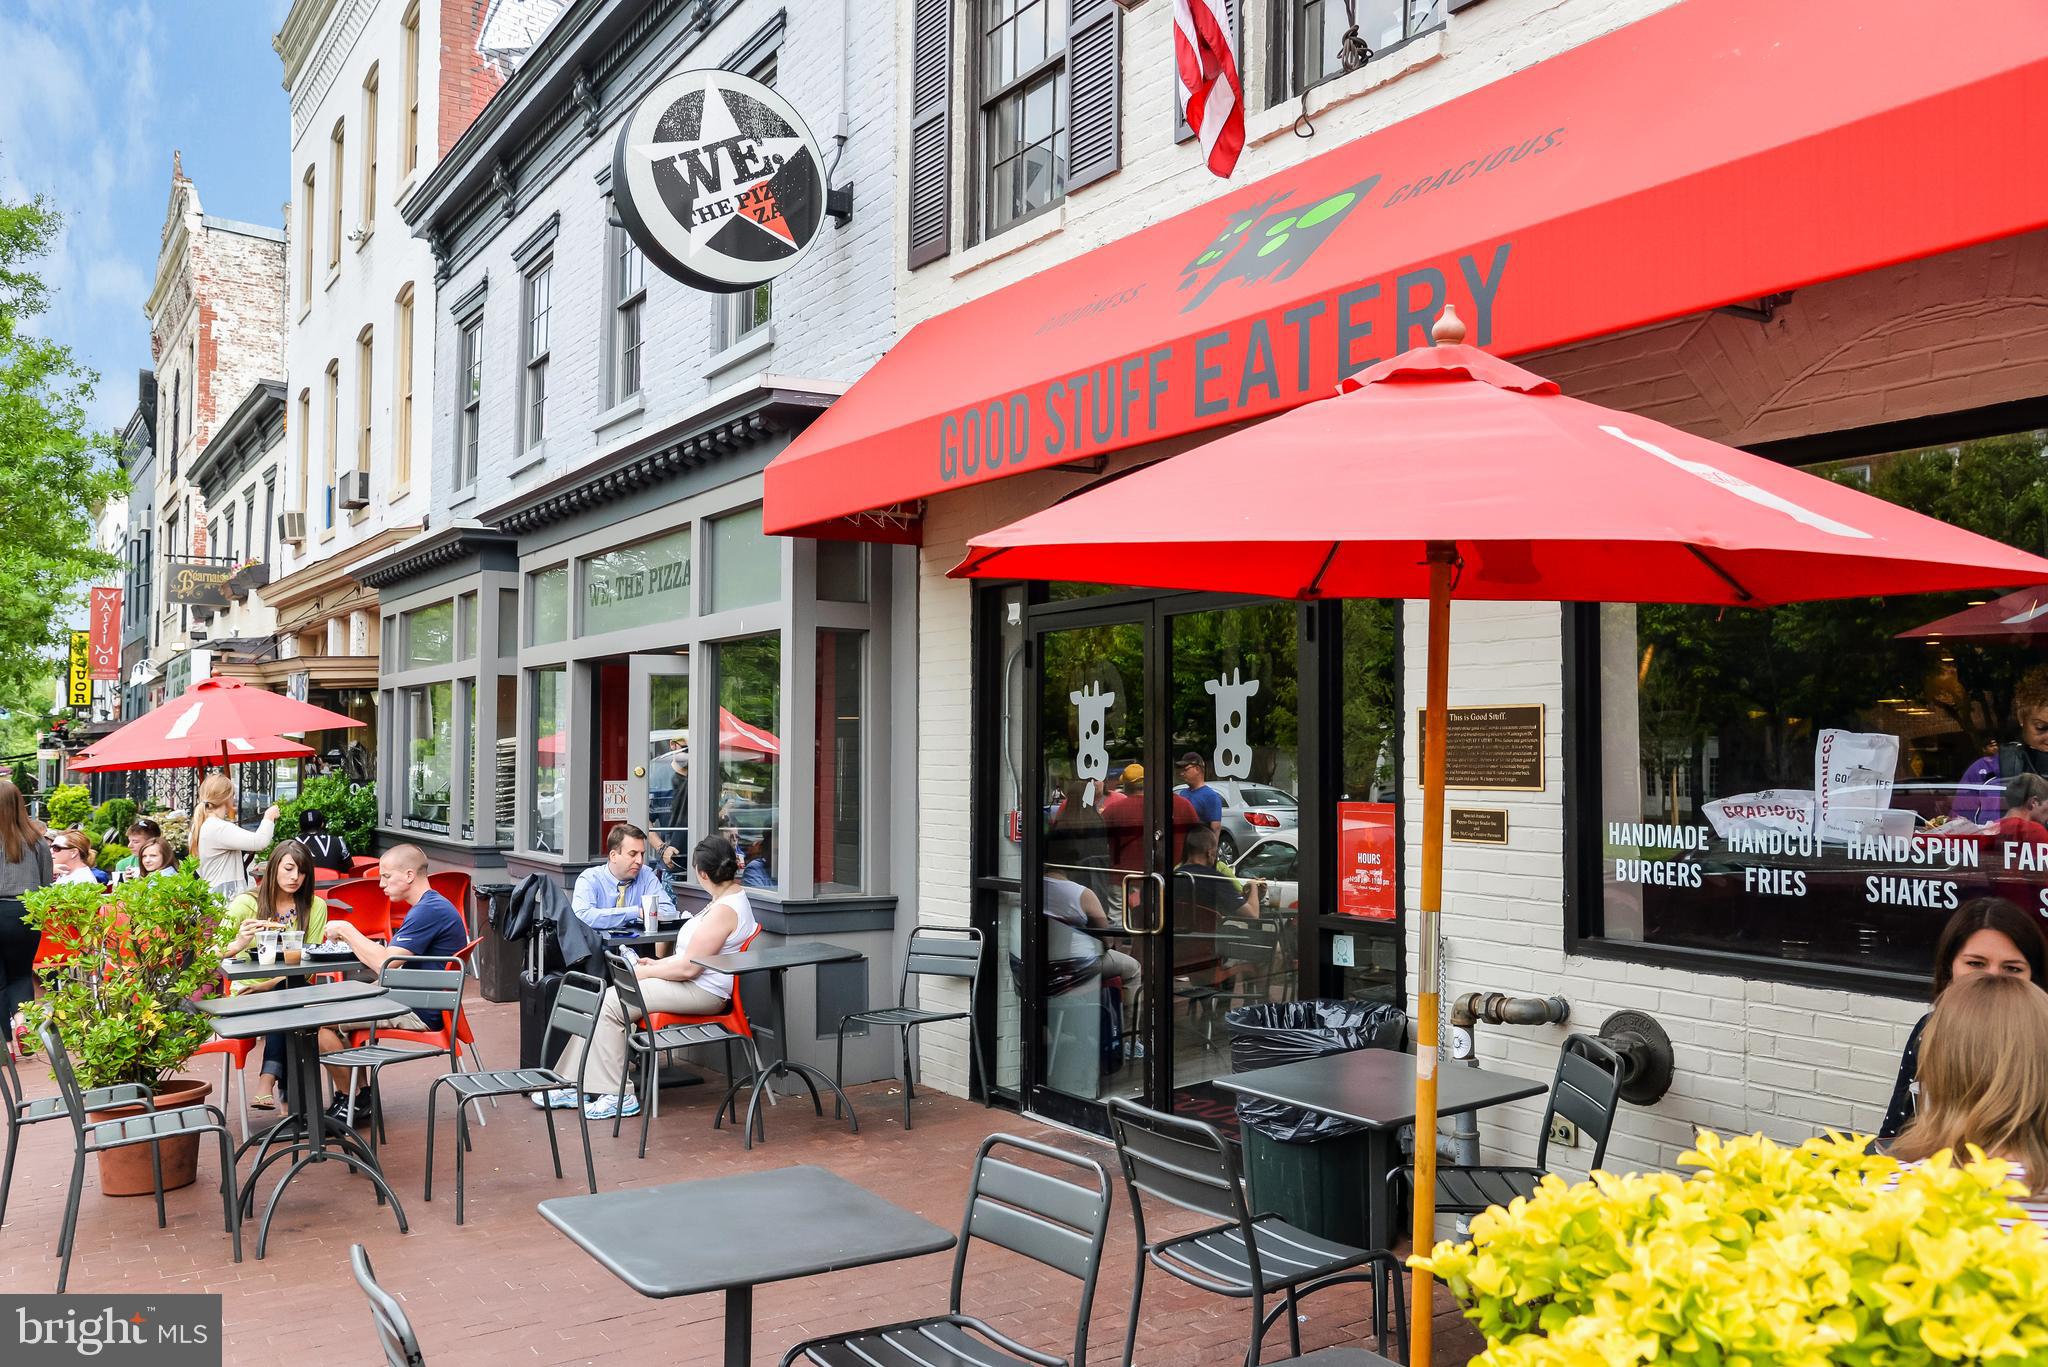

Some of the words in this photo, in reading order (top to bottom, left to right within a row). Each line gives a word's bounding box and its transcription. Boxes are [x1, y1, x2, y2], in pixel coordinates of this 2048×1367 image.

[939, 392, 1030, 482] GOOD
[1044, 349, 1172, 455] STUFF
[1194, 242, 1512, 418] EATERY
[616, 571, 643, 601] THE
[648, 558, 691, 594] PIZZA
[95, 590, 116, 665] MASSIMO
[1449, 713, 1463, 721] This
[1470, 712, 1488, 721] Good
[605, 783, 627, 794] BES
[1609, 822, 1710, 851] HANDMADE
[1728, 827, 1823, 858] HANDCUT
[1847, 834, 1979, 867] HANDSPUN
[1357, 852, 1381, 865] HOURS
[1615, 858, 1702, 888] BURGERS
[1745, 867, 1807, 897] FRIES
[1865, 875, 1959, 910] SHAKES
